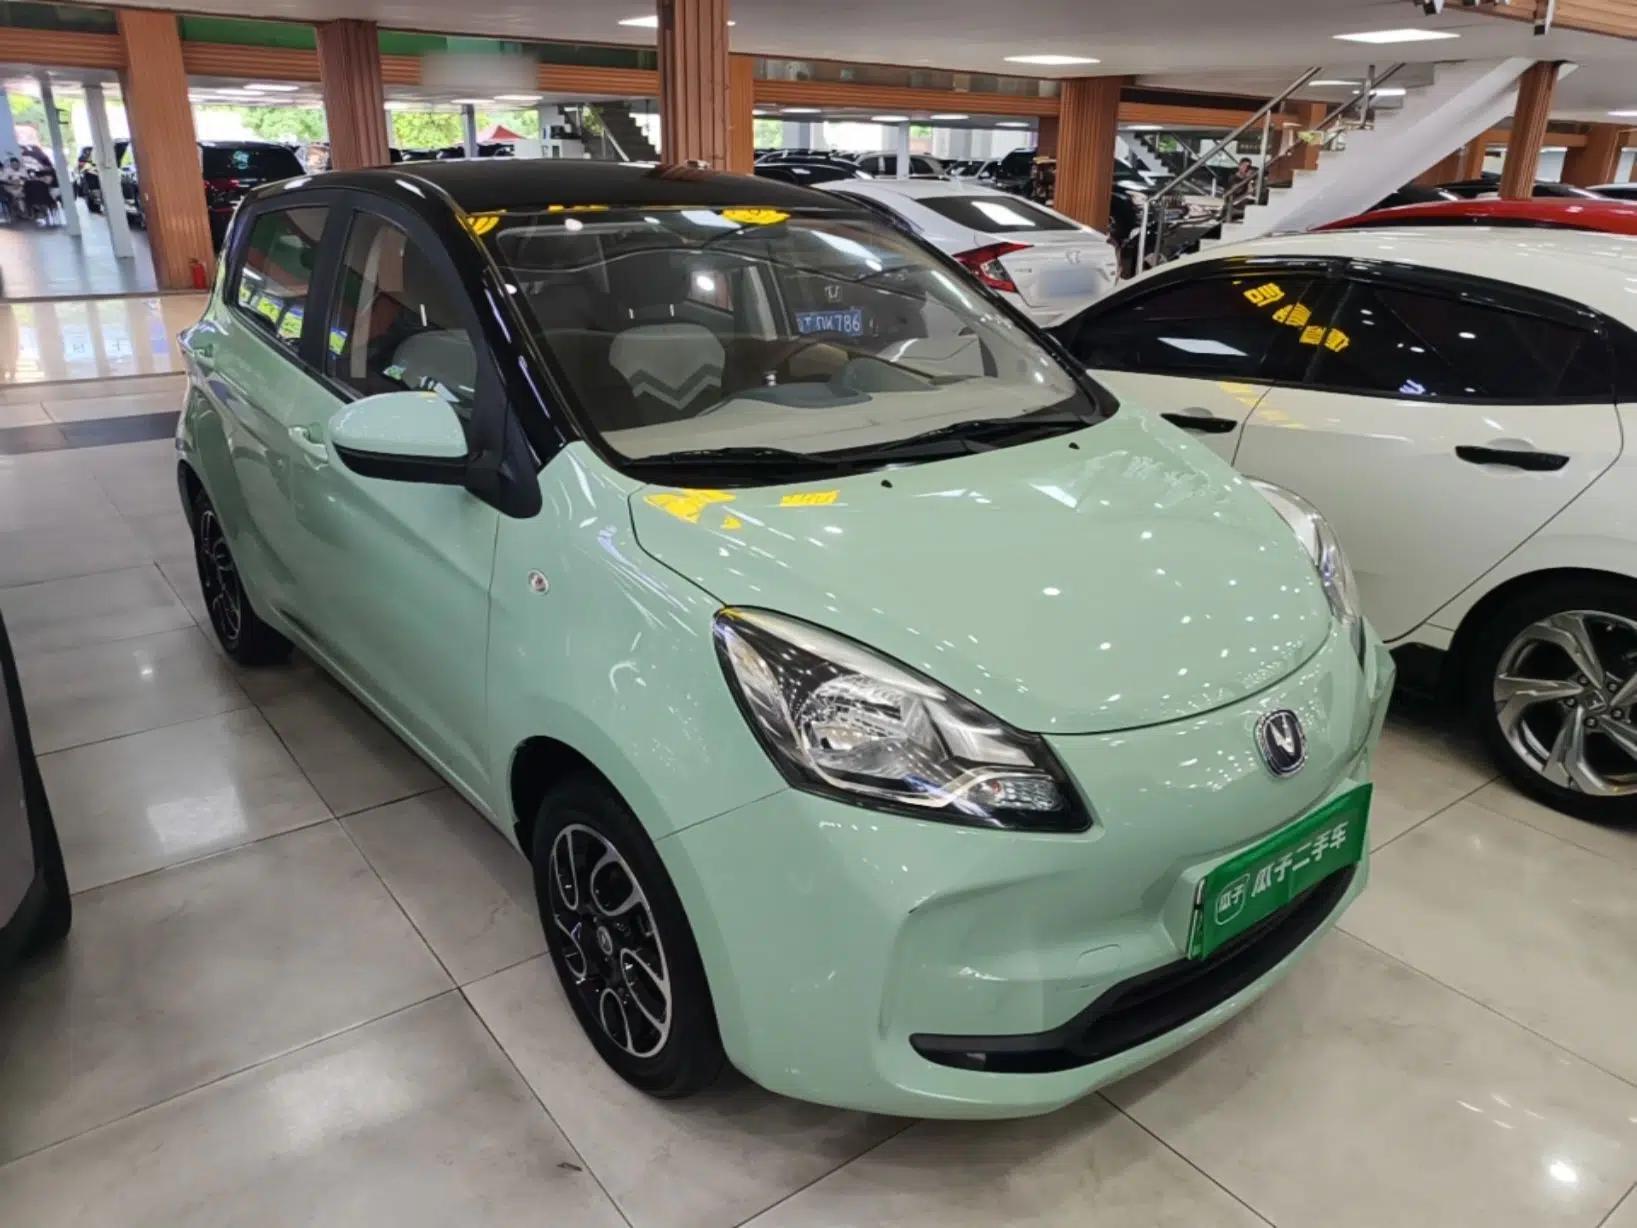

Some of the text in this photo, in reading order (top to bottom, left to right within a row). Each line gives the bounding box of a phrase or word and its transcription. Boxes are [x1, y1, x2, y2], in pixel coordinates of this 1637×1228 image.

[1250, 820, 1349, 898] 瓜子二手车
